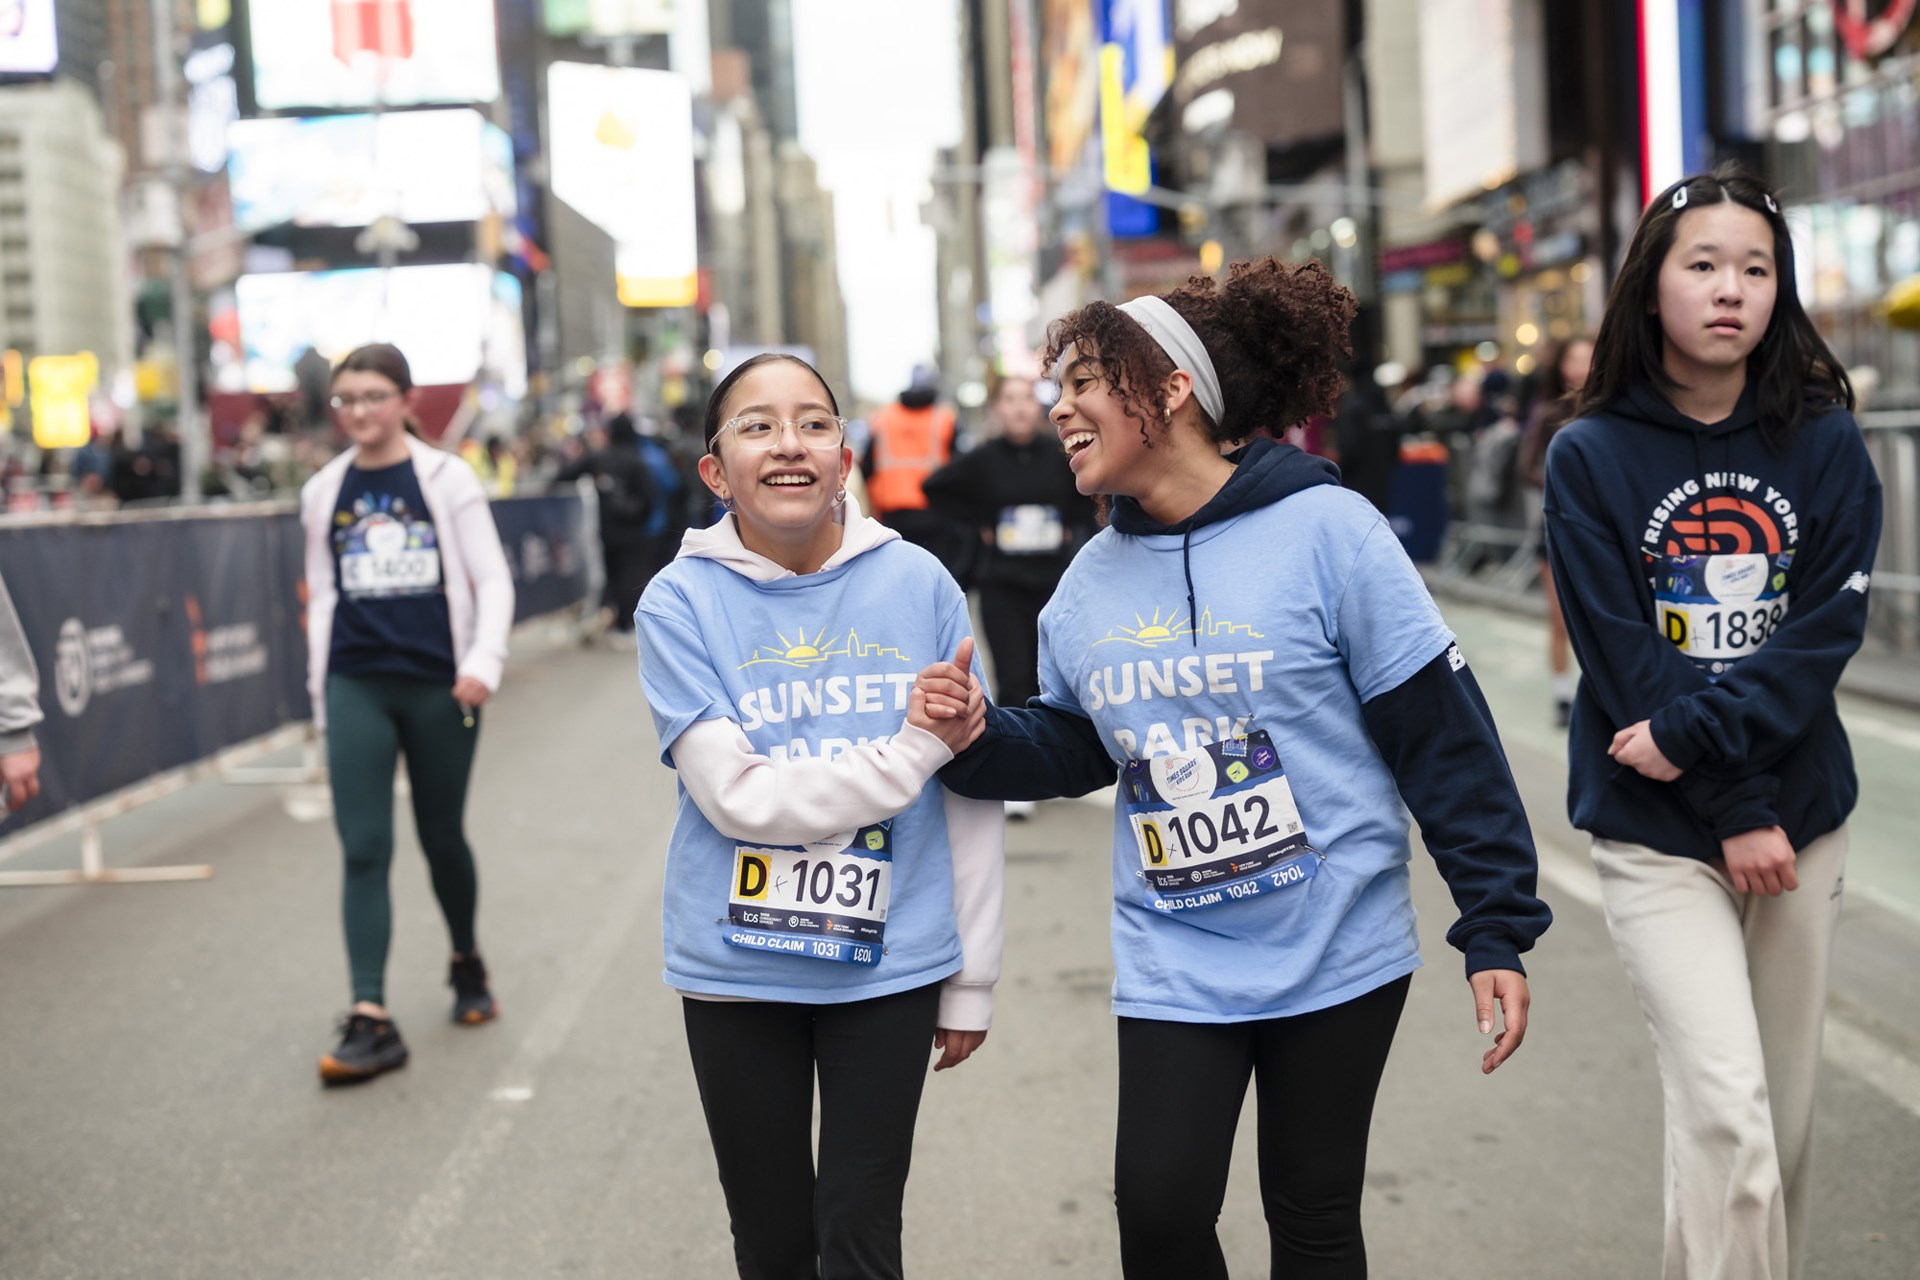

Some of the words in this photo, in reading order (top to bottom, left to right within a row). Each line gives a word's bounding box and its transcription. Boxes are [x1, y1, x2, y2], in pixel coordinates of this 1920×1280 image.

[1643, 479, 1700, 544] RISING
[1704, 472, 1760, 493] NEW
[1764, 486, 1799, 545] YORK
[1665, 610, 1687, 646] D
[1706, 603, 1782, 650] 1838
[738, 673, 918, 731] SUNSET
[1089, 650, 1274, 711] SUNSET
[1143, 824, 1163, 864] D
[1167, 795, 1279, 858] 1042
[739, 855, 768, 897] D
[792, 859, 881, 911] 1031
[1154, 899, 1184, 910] CHILD
[1184, 892, 1223, 908] CLAIM
[1226, 880, 1260, 899] 1042
[1271, 865, 1305, 887] 1042
[743, 910, 759, 923] tcs
[731, 933, 766, 946] CHILD
[767, 937, 805, 952] CLAIM
[812, 941, 840, 957] 1031
[853, 947, 872, 963] 1031
